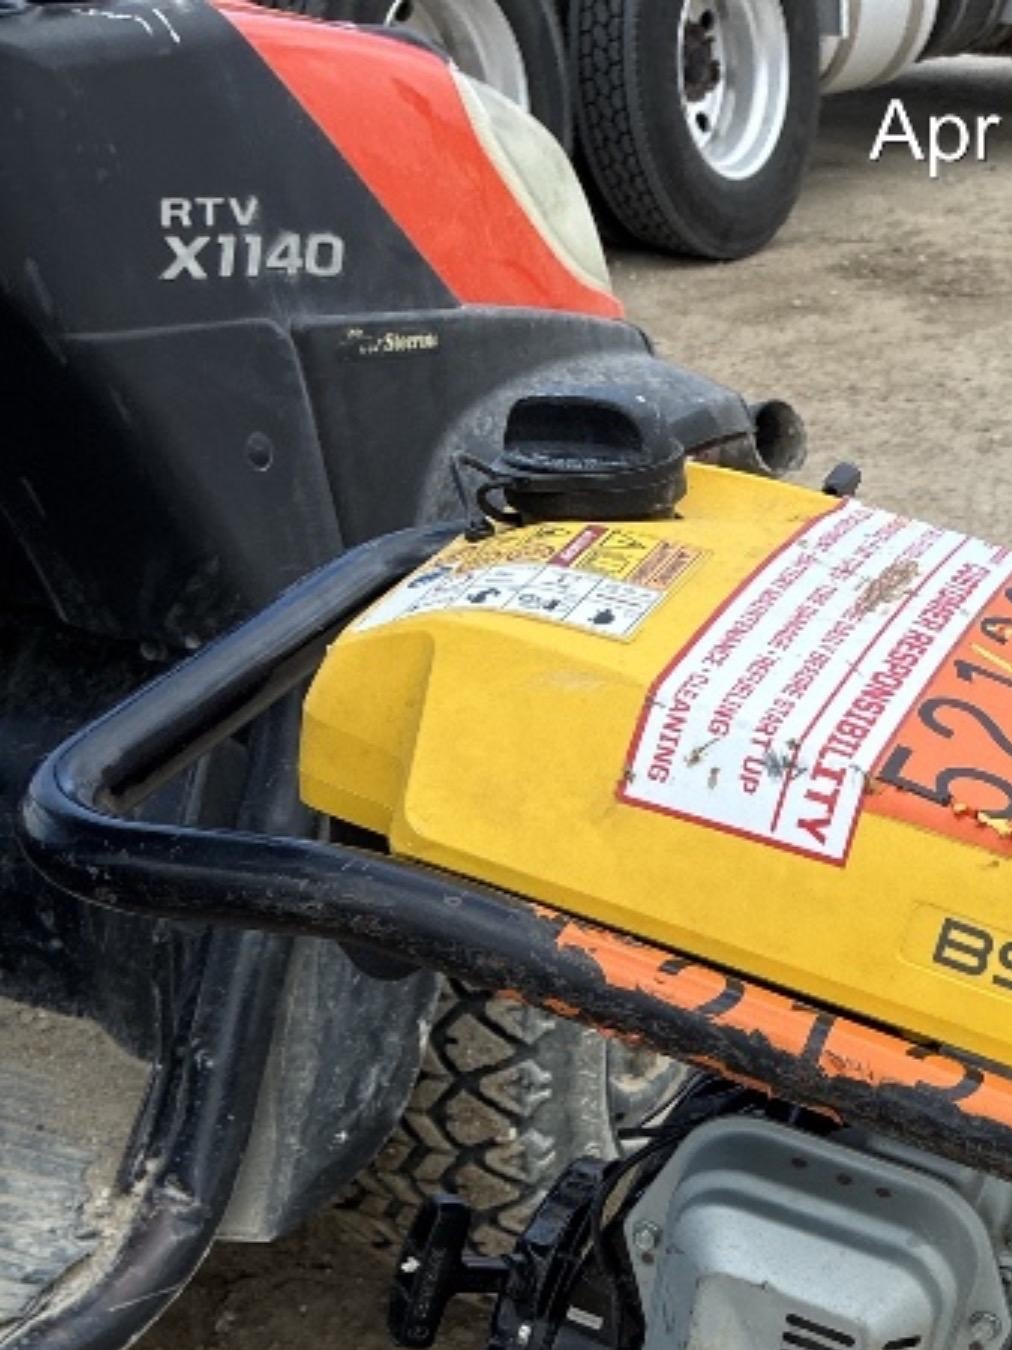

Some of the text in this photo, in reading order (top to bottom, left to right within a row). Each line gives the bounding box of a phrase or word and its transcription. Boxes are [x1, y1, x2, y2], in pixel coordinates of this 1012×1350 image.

[160, 196, 259, 228] RTV
[158, 231, 345, 280] X1140
[707, 653, 782, 737] REFUELING
[647, 671, 710, 784] CLEANING
[751, 698, 797, 754] START
[796, 629, 935, 846] RESPONSIBILITY
[739, 755, 766, 795] UP
